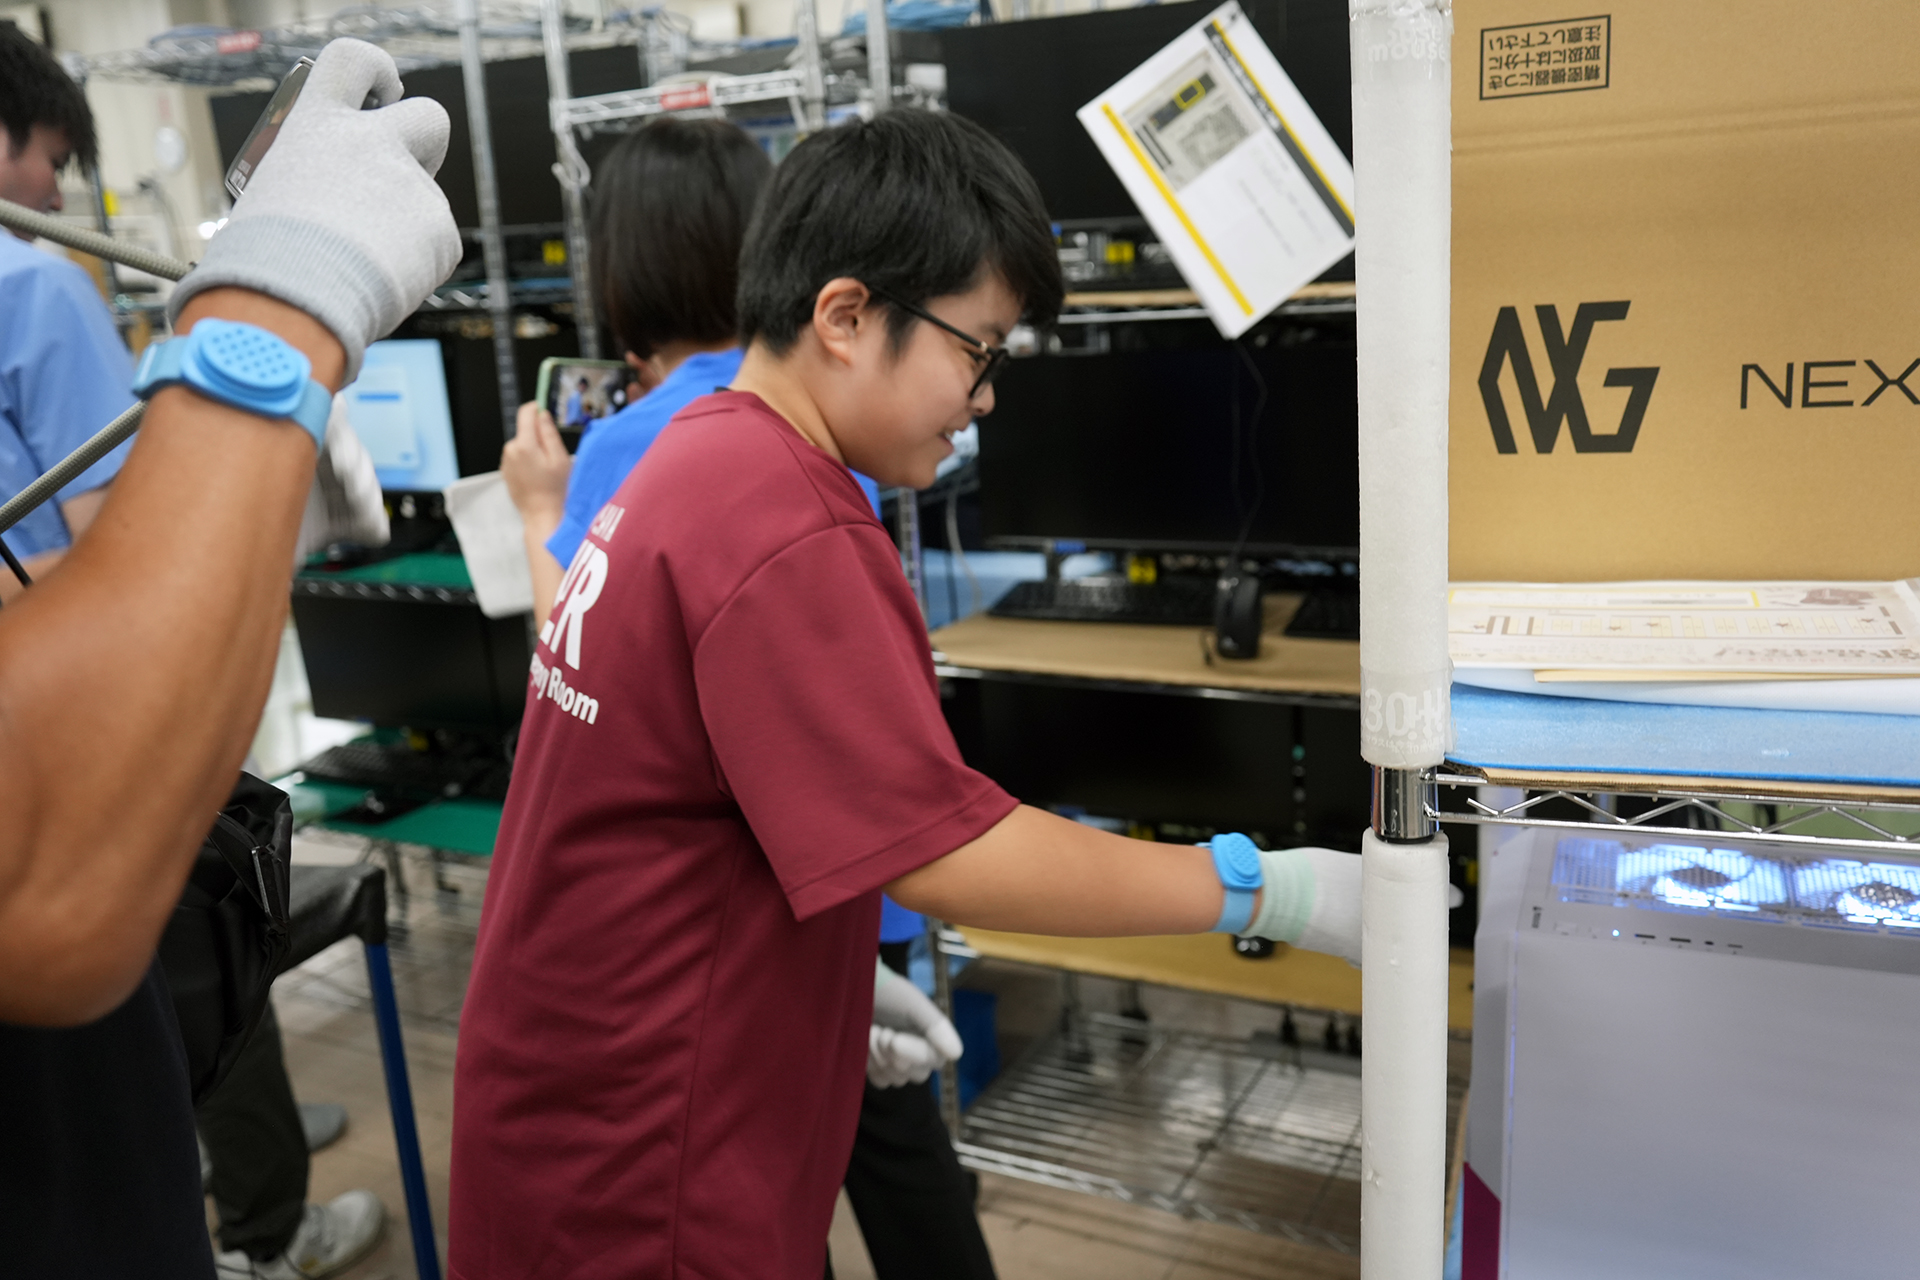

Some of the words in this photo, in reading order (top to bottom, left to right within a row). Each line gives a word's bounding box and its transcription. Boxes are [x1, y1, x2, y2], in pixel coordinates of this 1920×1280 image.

[1488, 25, 1601, 50] 注意して下さい
[1488, 45, 1601, 70] 取扱には十分に
[1740, 358, 1920, 409] NEX
[547, 666, 599, 725] Room
